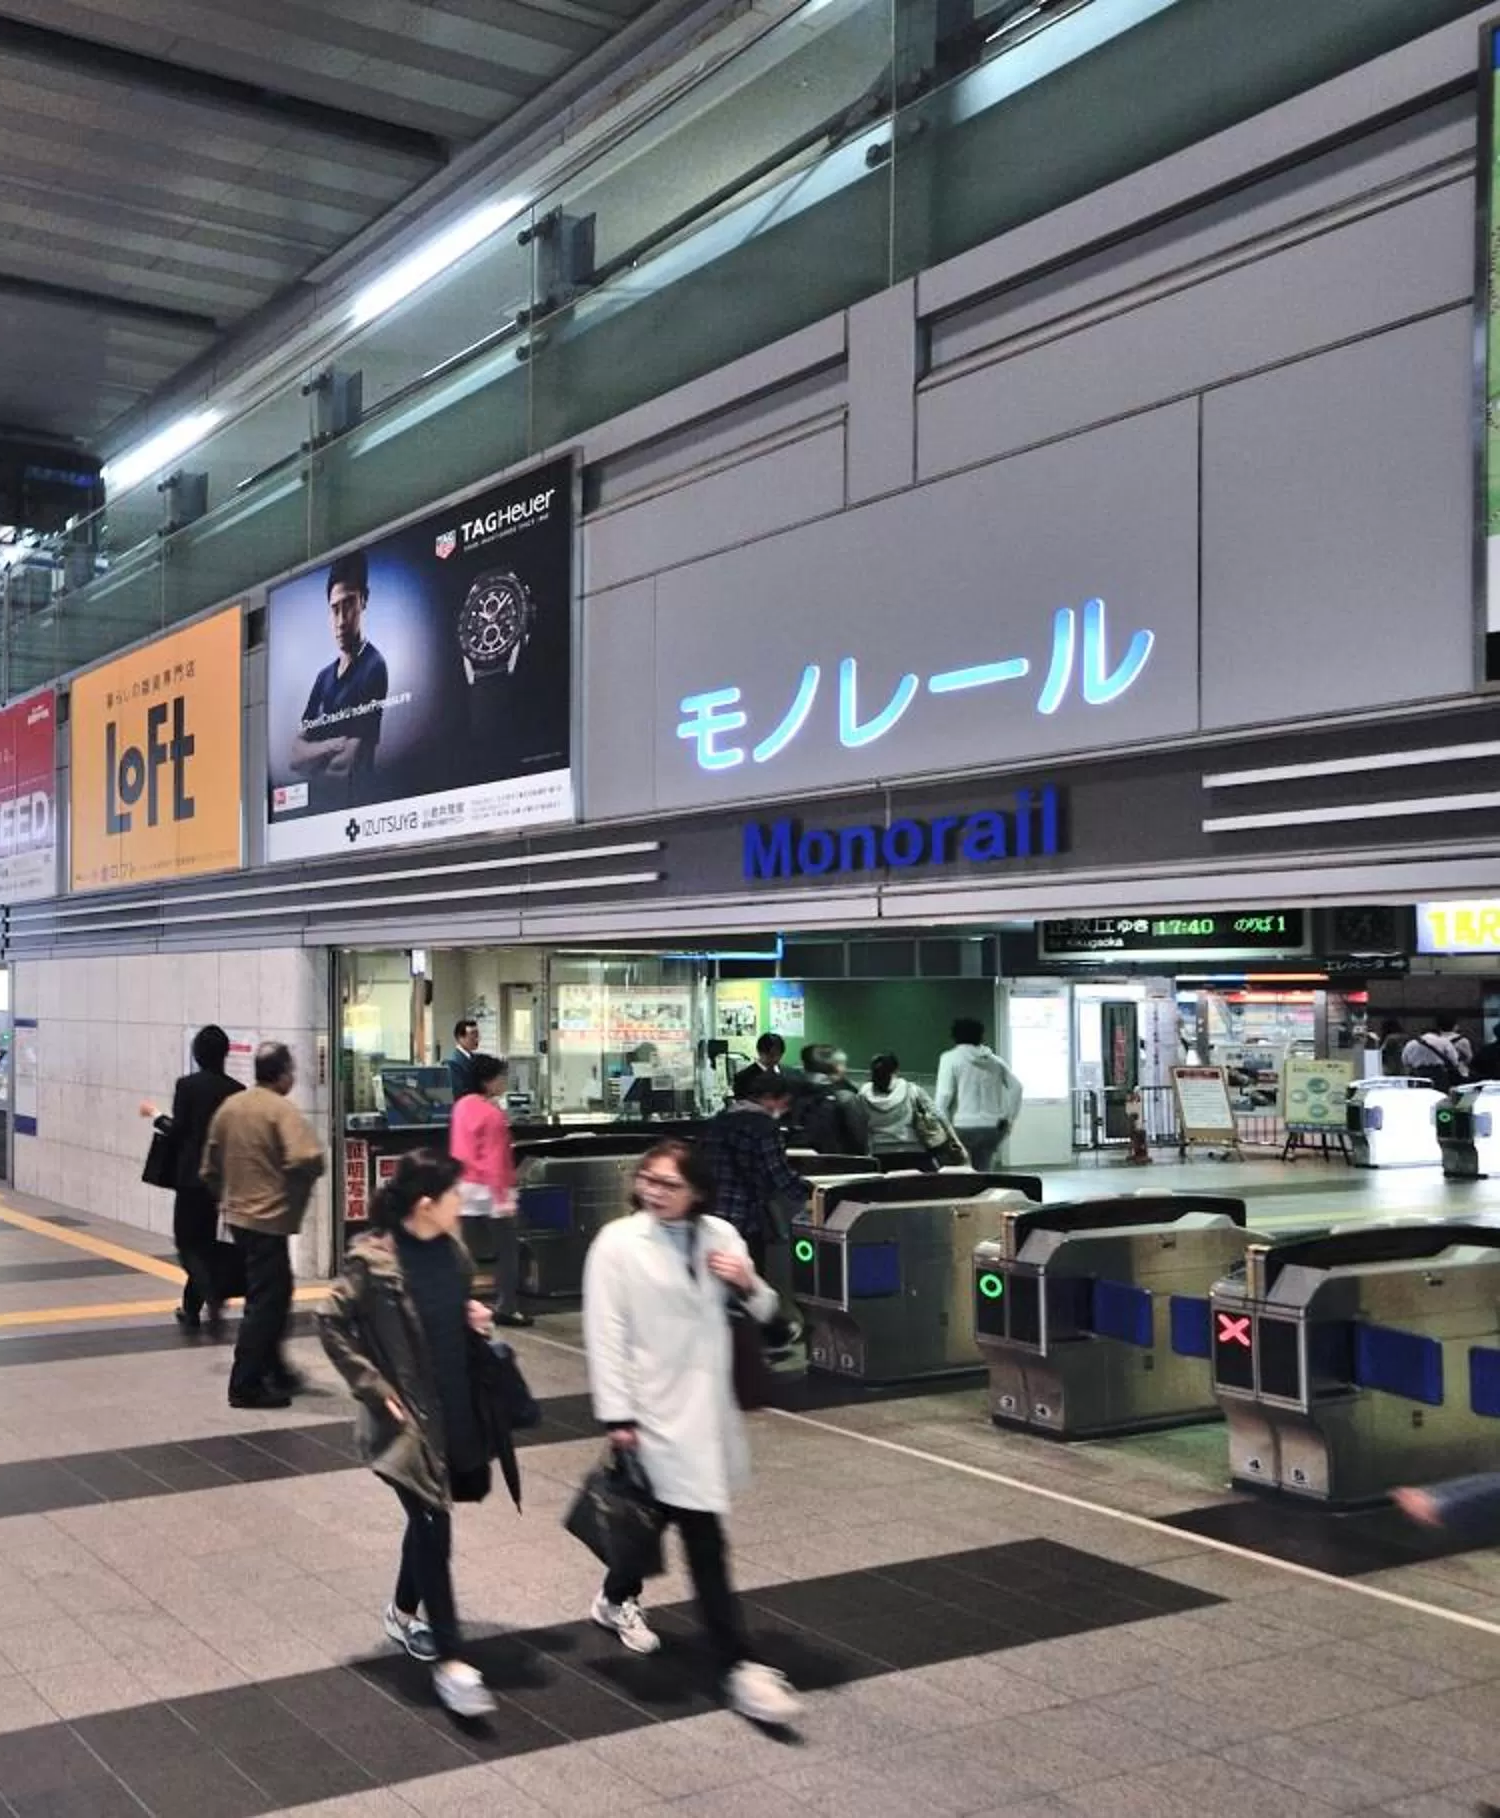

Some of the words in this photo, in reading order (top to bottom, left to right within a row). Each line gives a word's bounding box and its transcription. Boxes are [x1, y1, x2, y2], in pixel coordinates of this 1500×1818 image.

[676, 597, 1156, 771] モノレール
[742, 783, 1060, 881] Monorail
[1155, 918, 1214, 936] 17:40
